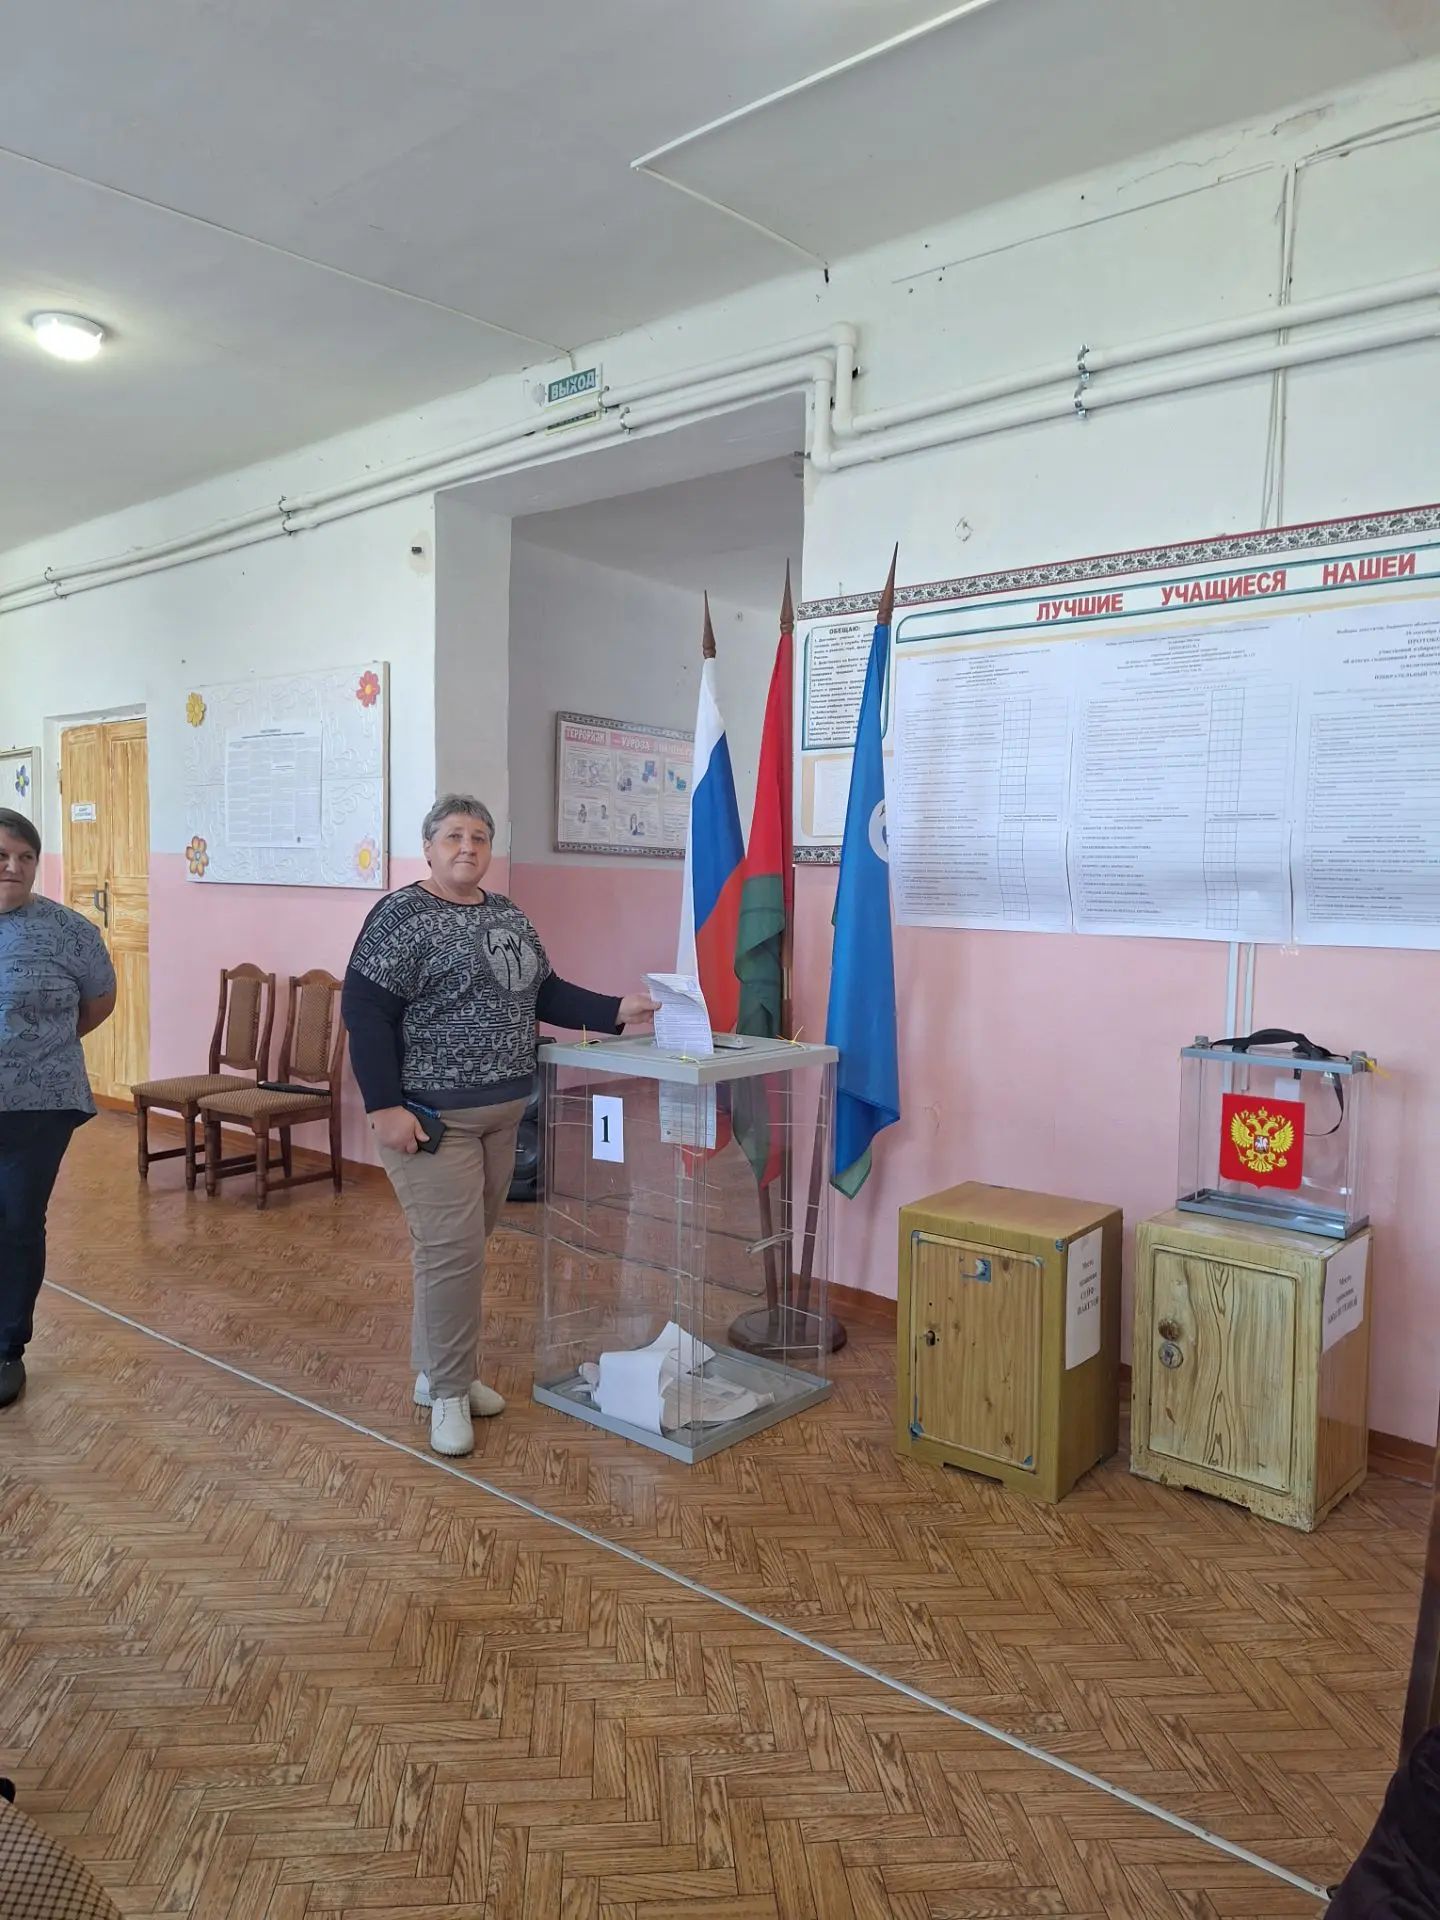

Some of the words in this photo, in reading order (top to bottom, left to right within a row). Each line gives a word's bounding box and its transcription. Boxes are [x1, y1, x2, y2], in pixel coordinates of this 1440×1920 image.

[551, 371, 595, 400] ВЫХОД
[1036, 593, 1123, 621] ЛУЧШИЕ
[1162, 569, 1287, 605] УЧАЩИЕСЯ
[600, 1115, 611, 1144] 1
